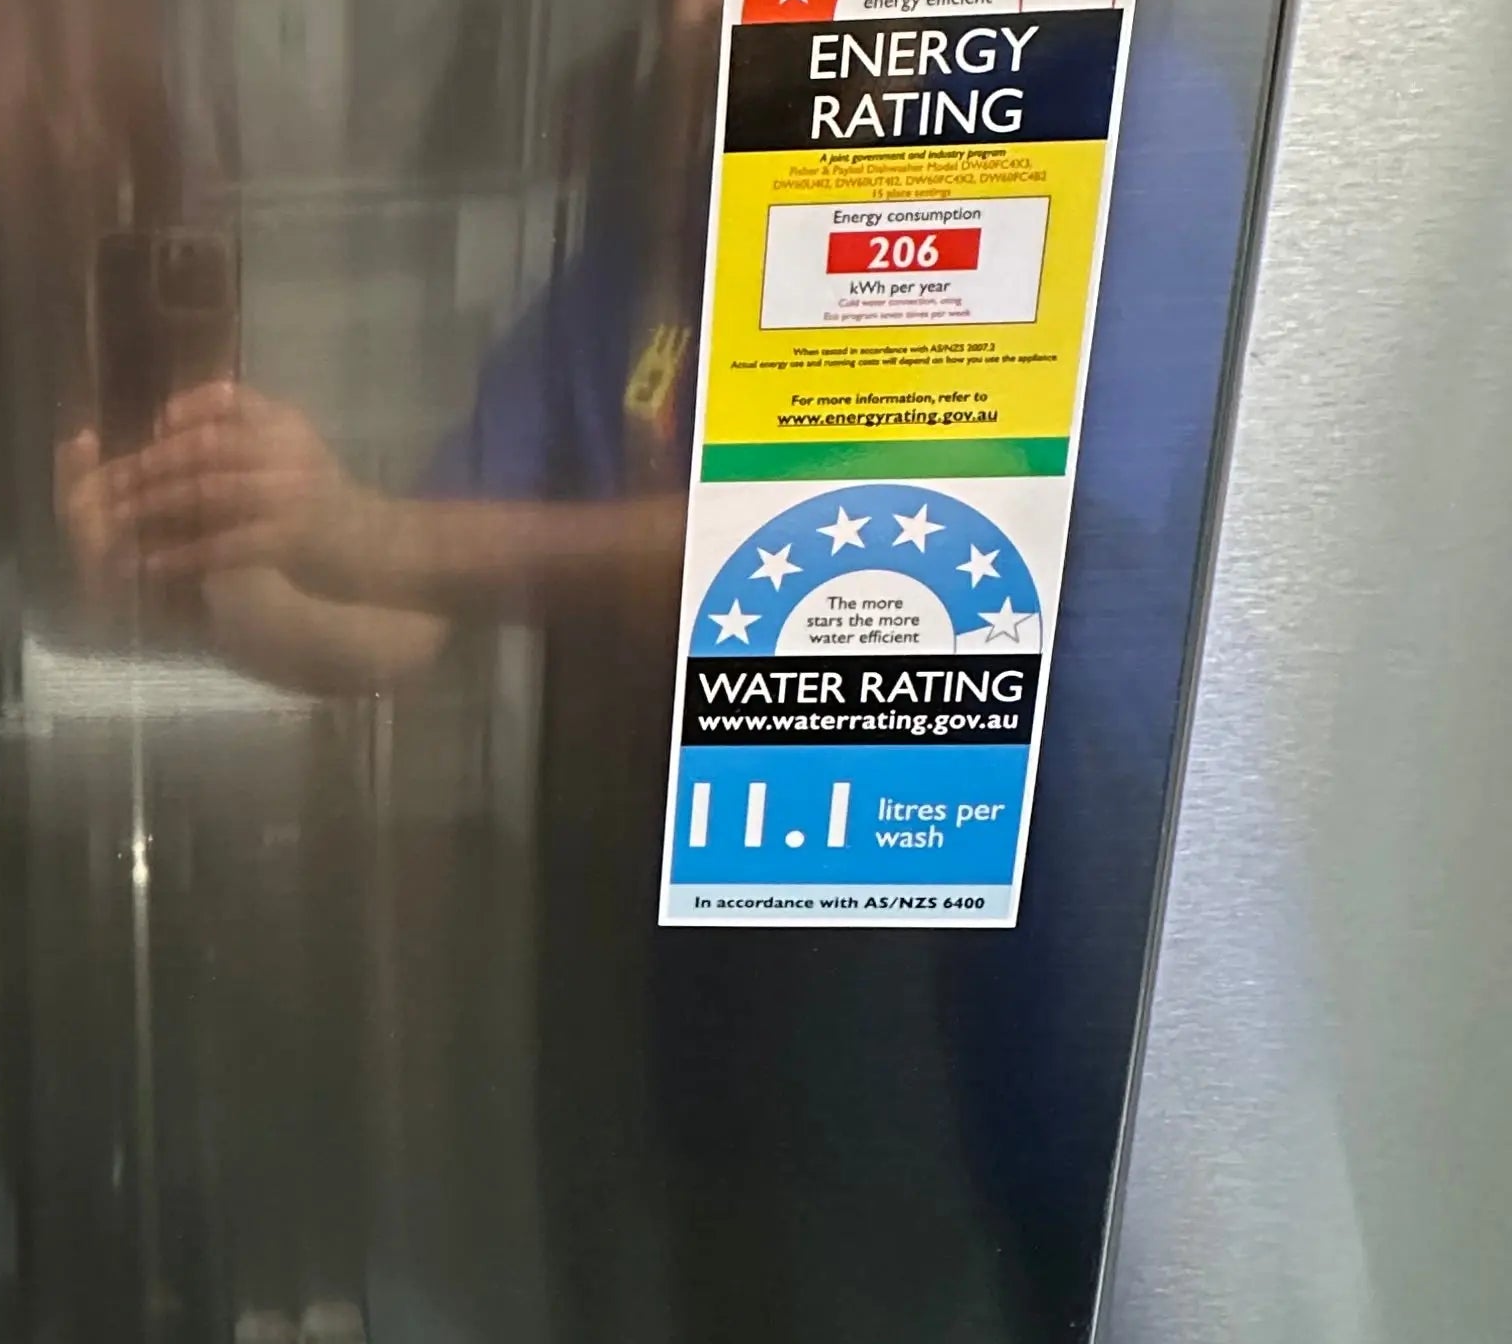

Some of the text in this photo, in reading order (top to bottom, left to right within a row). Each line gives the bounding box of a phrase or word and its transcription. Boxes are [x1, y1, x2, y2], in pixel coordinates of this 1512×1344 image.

[809, 25, 1039, 81] ENERGY
[810, 88, 1025, 141] RATING
[832, 207, 981, 226] Energy consumption
[867, 234, 940, 270] 206
[849, 280, 951, 298] kWh per year
[791, 391, 988, 406] For more information, refer to
[777, 408, 998, 428] www.energyrating.gov.au
[827, 596, 904, 610] The more
[806, 612, 920, 628] stars the more
[809, 630, 920, 644] water efficient
[698, 669, 1025, 705] WATER RATING
[698, 709, 1020, 735] www.waterrating.gov.au
[688, 782, 851, 848] 11.1
[877, 797, 1005, 828] litres per
[874, 824, 945, 849] wash
[694, 896, 986, 911] In accordance with AS/NZS 6400
